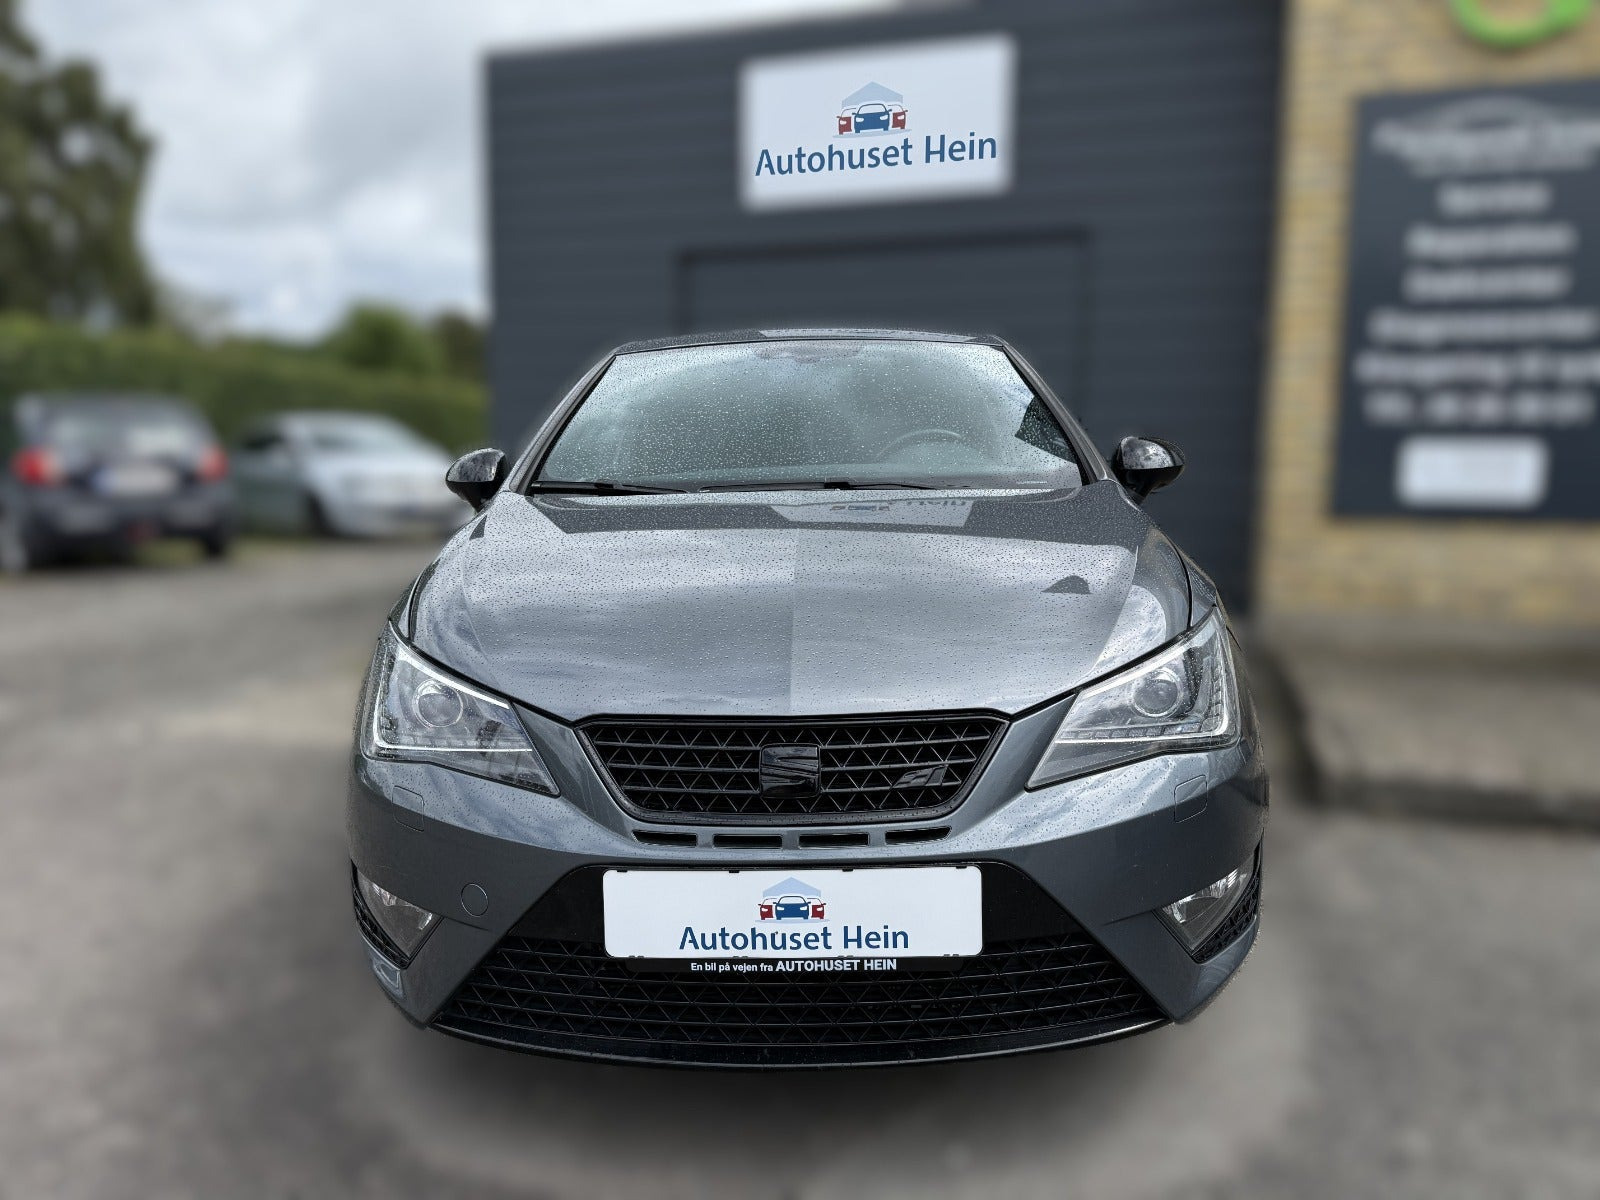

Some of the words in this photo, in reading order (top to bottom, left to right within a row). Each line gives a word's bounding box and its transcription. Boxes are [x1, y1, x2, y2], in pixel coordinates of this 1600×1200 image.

[755, 137, 913, 177] Autohuset
[925, 131, 997, 164] Hein
[679, 926, 832, 951] Autohuset
[843, 924, 909, 950] Hein
[690, 962, 703, 971] En
[704, 962, 717, 971] bil
[718, 961, 731, 974] på
[732, 962, 758, 974] vejen
[759, 962, 774, 972] fra
[775, 959, 861, 972] AUTOHUSET
[863, 958, 897, 971] HEIN
